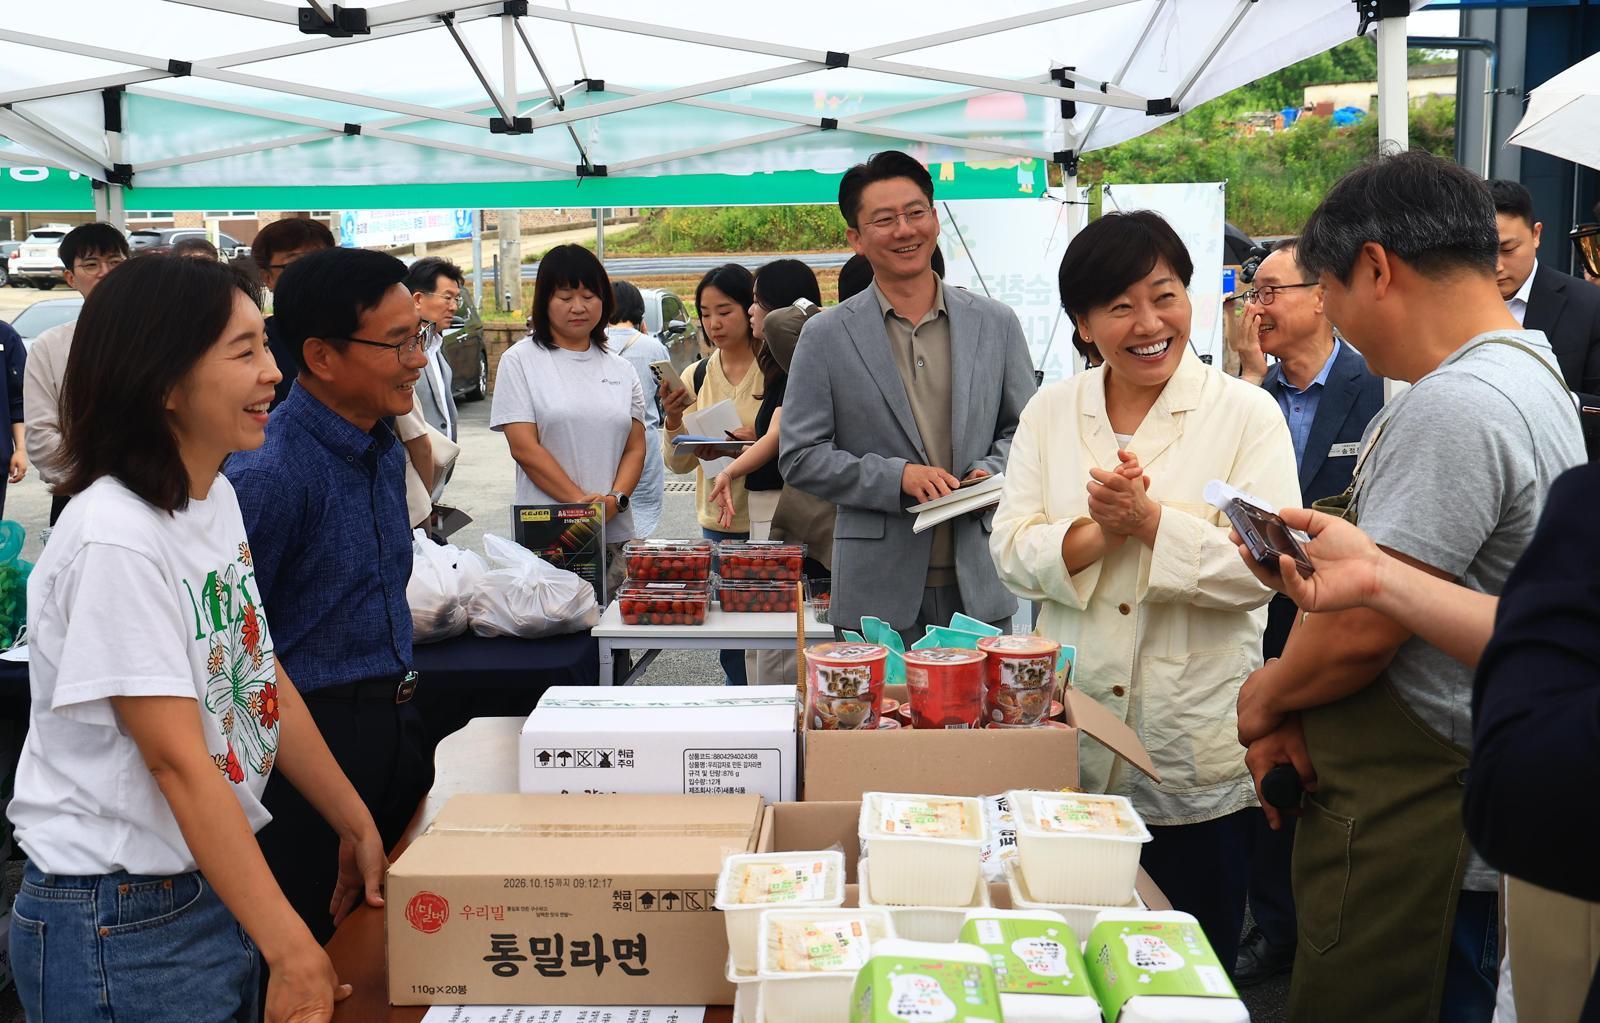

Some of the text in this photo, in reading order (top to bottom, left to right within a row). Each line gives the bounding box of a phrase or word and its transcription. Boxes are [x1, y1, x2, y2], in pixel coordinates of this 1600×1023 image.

[617, 749, 634, 758] 취급
[617, 759, 634, 768] 주의
[503, 878, 613, 888] 2026.10.15까지 09:12:17
[612, 890, 632, 900] 취급
[612, 901, 632, 911] 주의
[459, 904, 505, 921] 우리밀
[483, 932, 650, 977] 통밀라면
